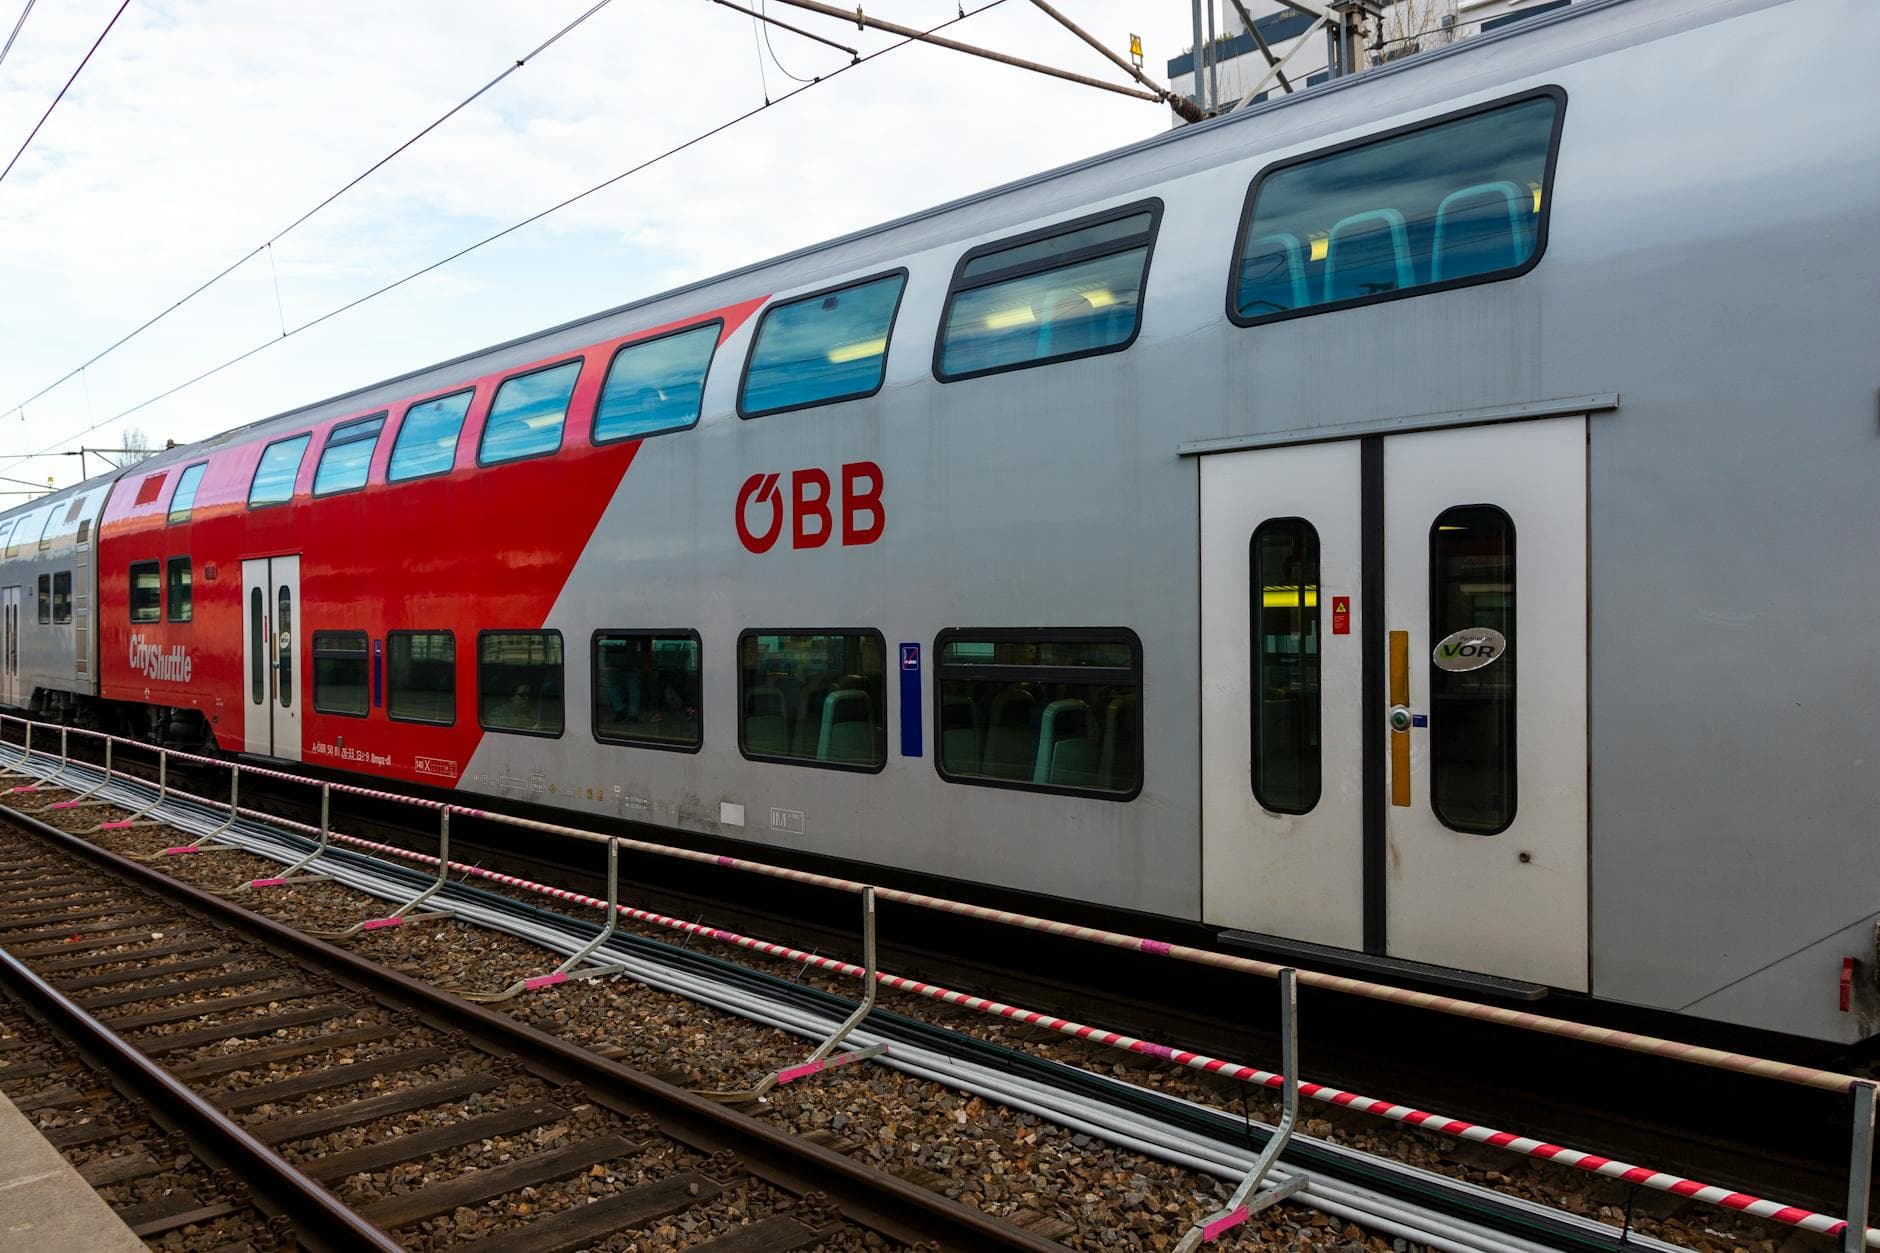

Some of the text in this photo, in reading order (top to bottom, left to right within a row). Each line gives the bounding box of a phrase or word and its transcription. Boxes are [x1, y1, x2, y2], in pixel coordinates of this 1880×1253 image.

[735, 461, 886, 554] ÖBB
[129, 633, 192, 683] CityShuttle
[1444, 641, 1495, 658] VOR
[772, 811, 786, 827] IM
